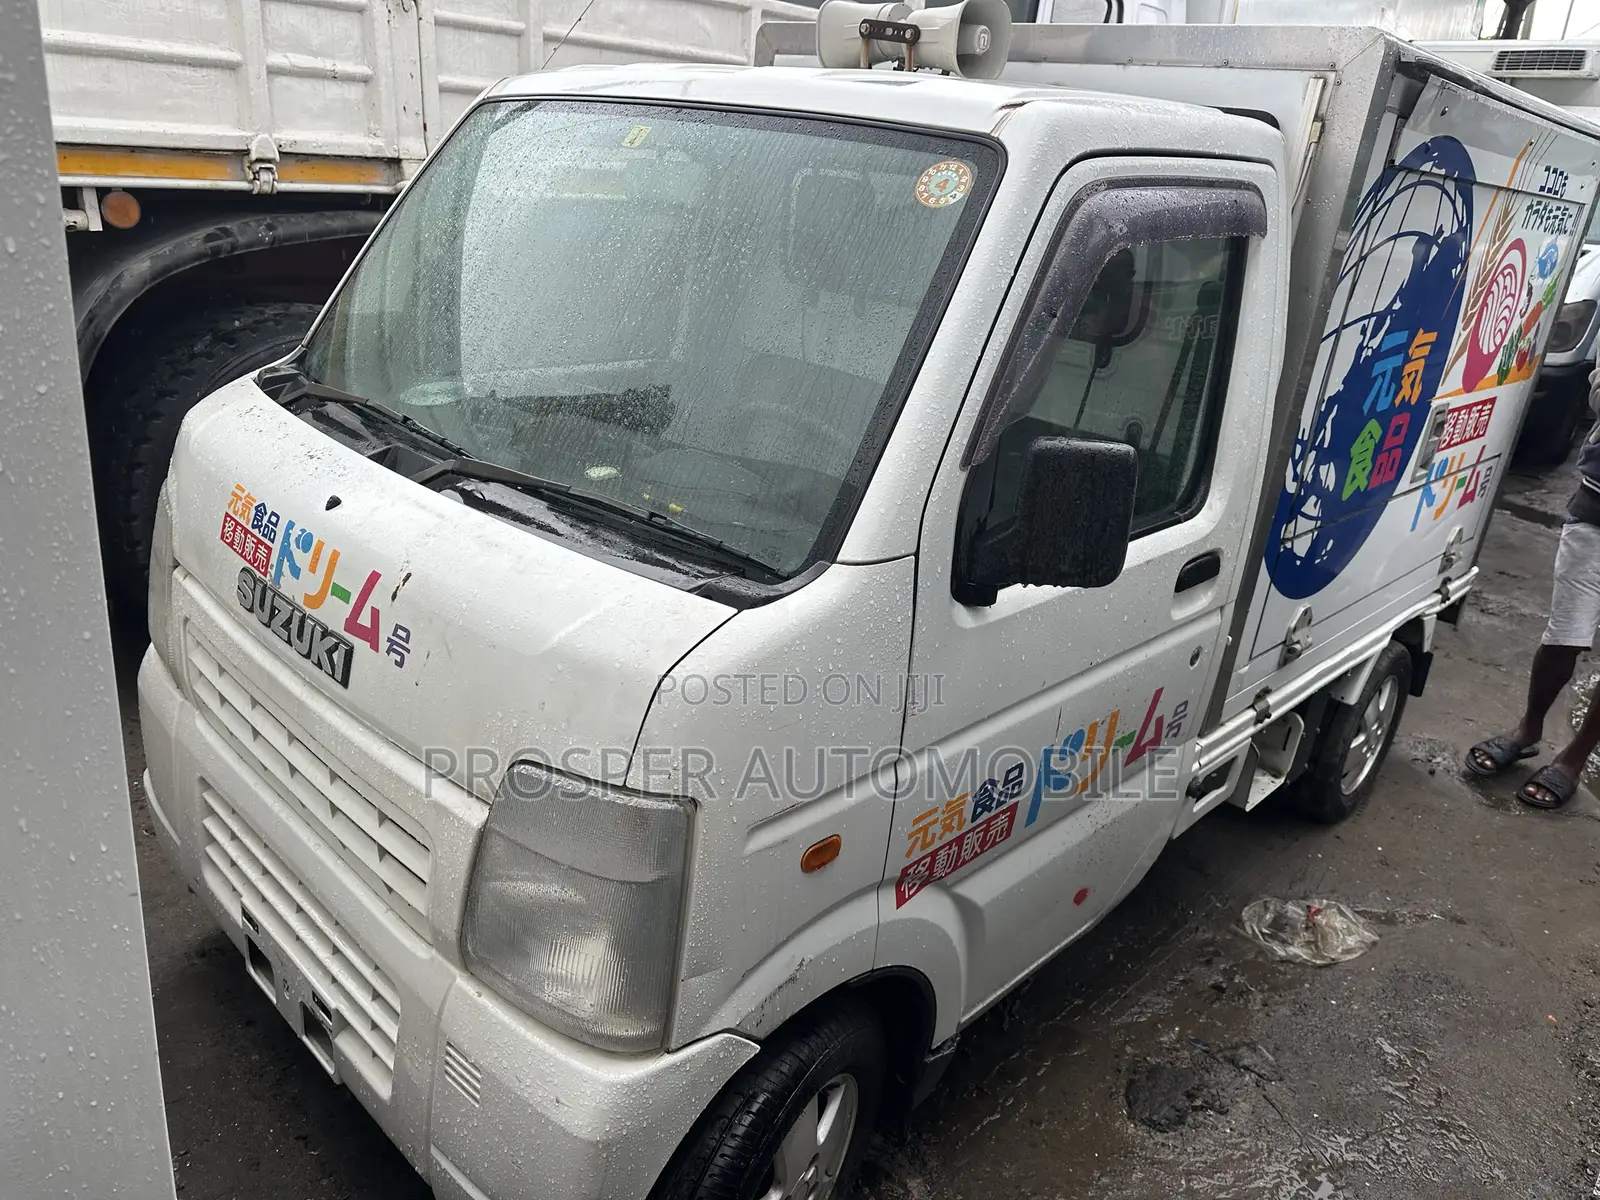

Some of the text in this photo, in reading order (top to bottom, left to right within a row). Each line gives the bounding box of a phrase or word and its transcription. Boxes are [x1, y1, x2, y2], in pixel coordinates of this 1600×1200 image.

[1539, 165, 1569, 199] ココロも
[1363, 328, 1438, 416] 元気
[1342, 412, 1411, 501] 食品
[1440, 402, 1493, 449] 移動販売
[1410, 445, 1493, 532] ドリーム号
[223, 516, 269, 573] 移動販売
[237, 566, 355, 689] SUZUKI
[272, 519, 412, 669] ドリーム号
[900, 811, 1012, 899] 移動販売
